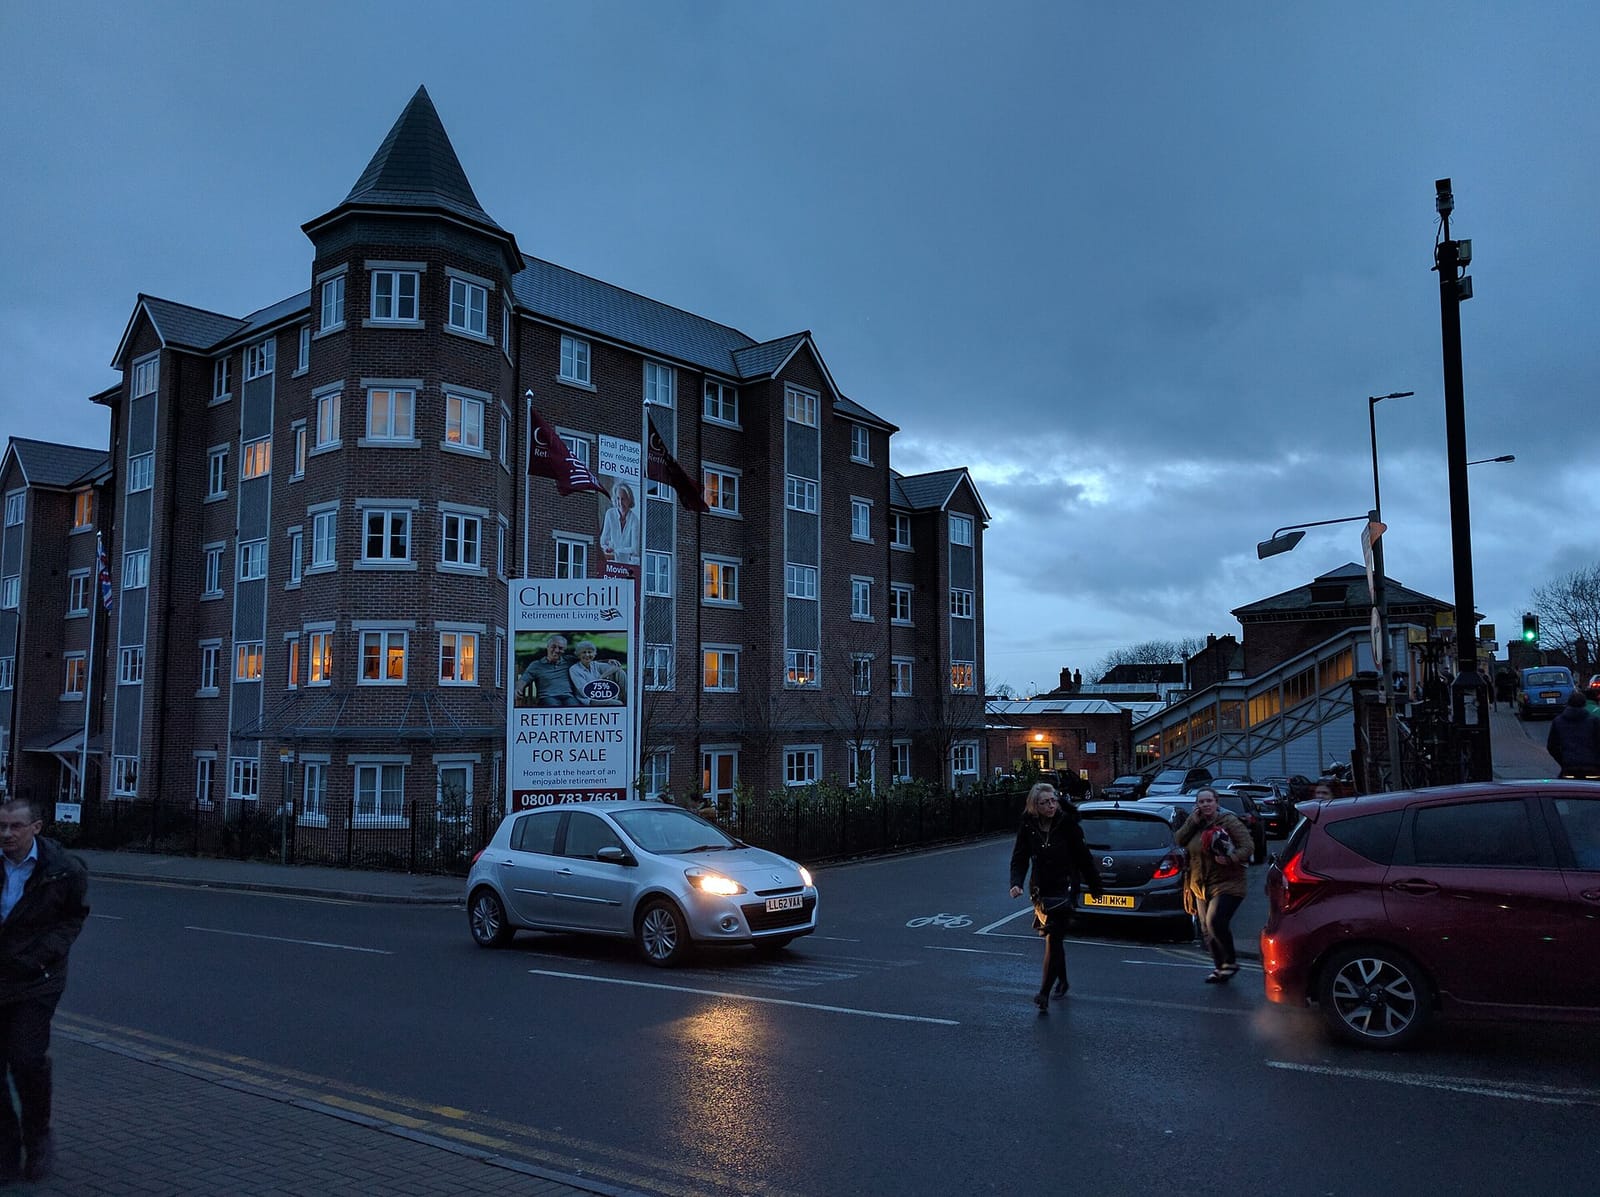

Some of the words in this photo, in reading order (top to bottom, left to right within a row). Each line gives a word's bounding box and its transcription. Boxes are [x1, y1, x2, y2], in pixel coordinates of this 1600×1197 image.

[600, 438, 618, 449] Final
[619, 443, 640, 455] phase
[600, 460, 617, 472] FOR
[619, 464, 639, 477] SALE
[519, 586, 618, 606] Churchill
[521, 611, 569, 620] Retirement
[572, 610, 599, 621] Living
[593, 682, 610, 690] 75%
[590, 690, 613, 699] SOLD
[520, 712, 620, 726] RETIREMENT
[516, 729, 623, 744] APARTMENTS
[533, 749, 564, 762] FOR
[569, 748, 607, 762] SALE
[523, 769, 545, 777] Home
[576, 768, 596, 776] heart
[532, 778, 567, 787] enjoyable
[569, 777, 607, 785] retirement
[521, 793, 554, 806] 0800
[558, 793, 583, 804] 783
[587, 792, 619, 801] 7661
[768, 898, 788, 910] LL62
